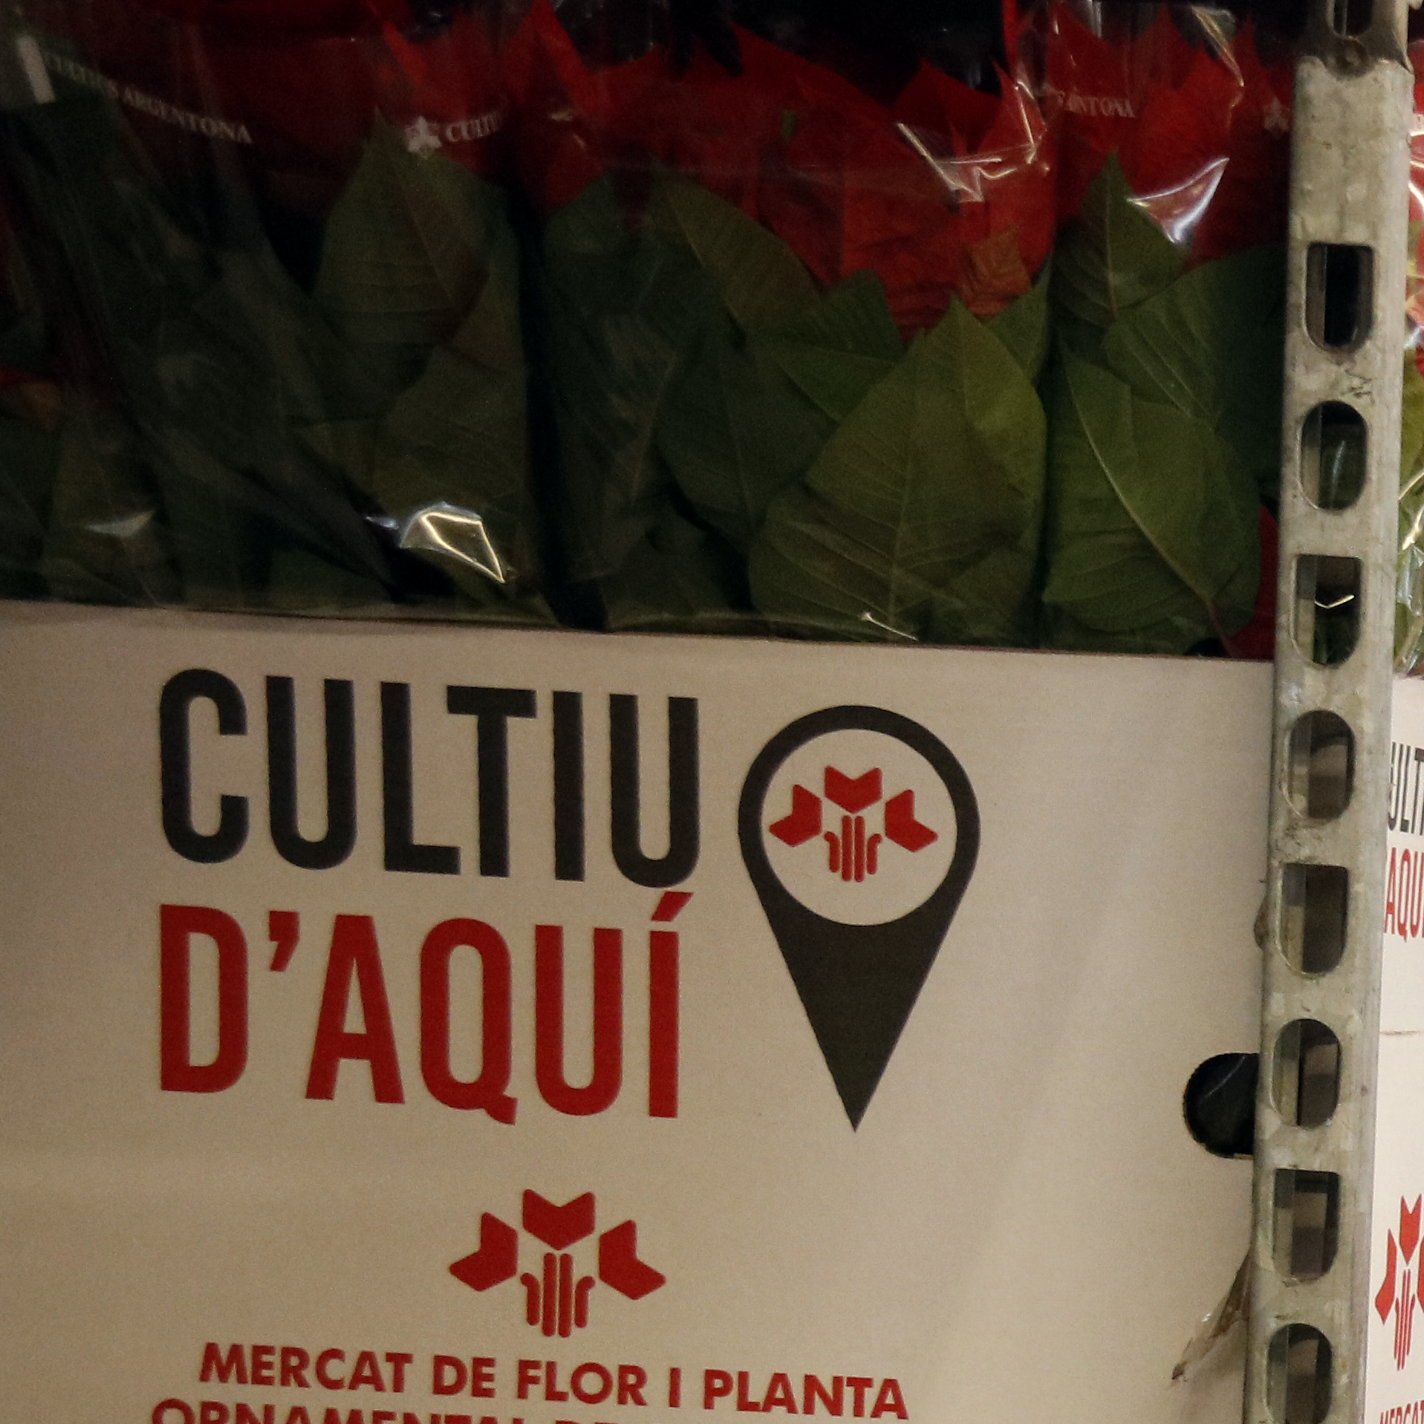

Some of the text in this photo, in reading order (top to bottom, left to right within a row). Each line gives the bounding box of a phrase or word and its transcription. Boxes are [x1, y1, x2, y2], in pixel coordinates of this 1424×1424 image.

[159, 668, 700, 889] CULTIU
[159, 891, 694, 1126] D'AQUÍ
[200, 1342, 910, 1420] MERCAT DE FLOR I PLANTA
